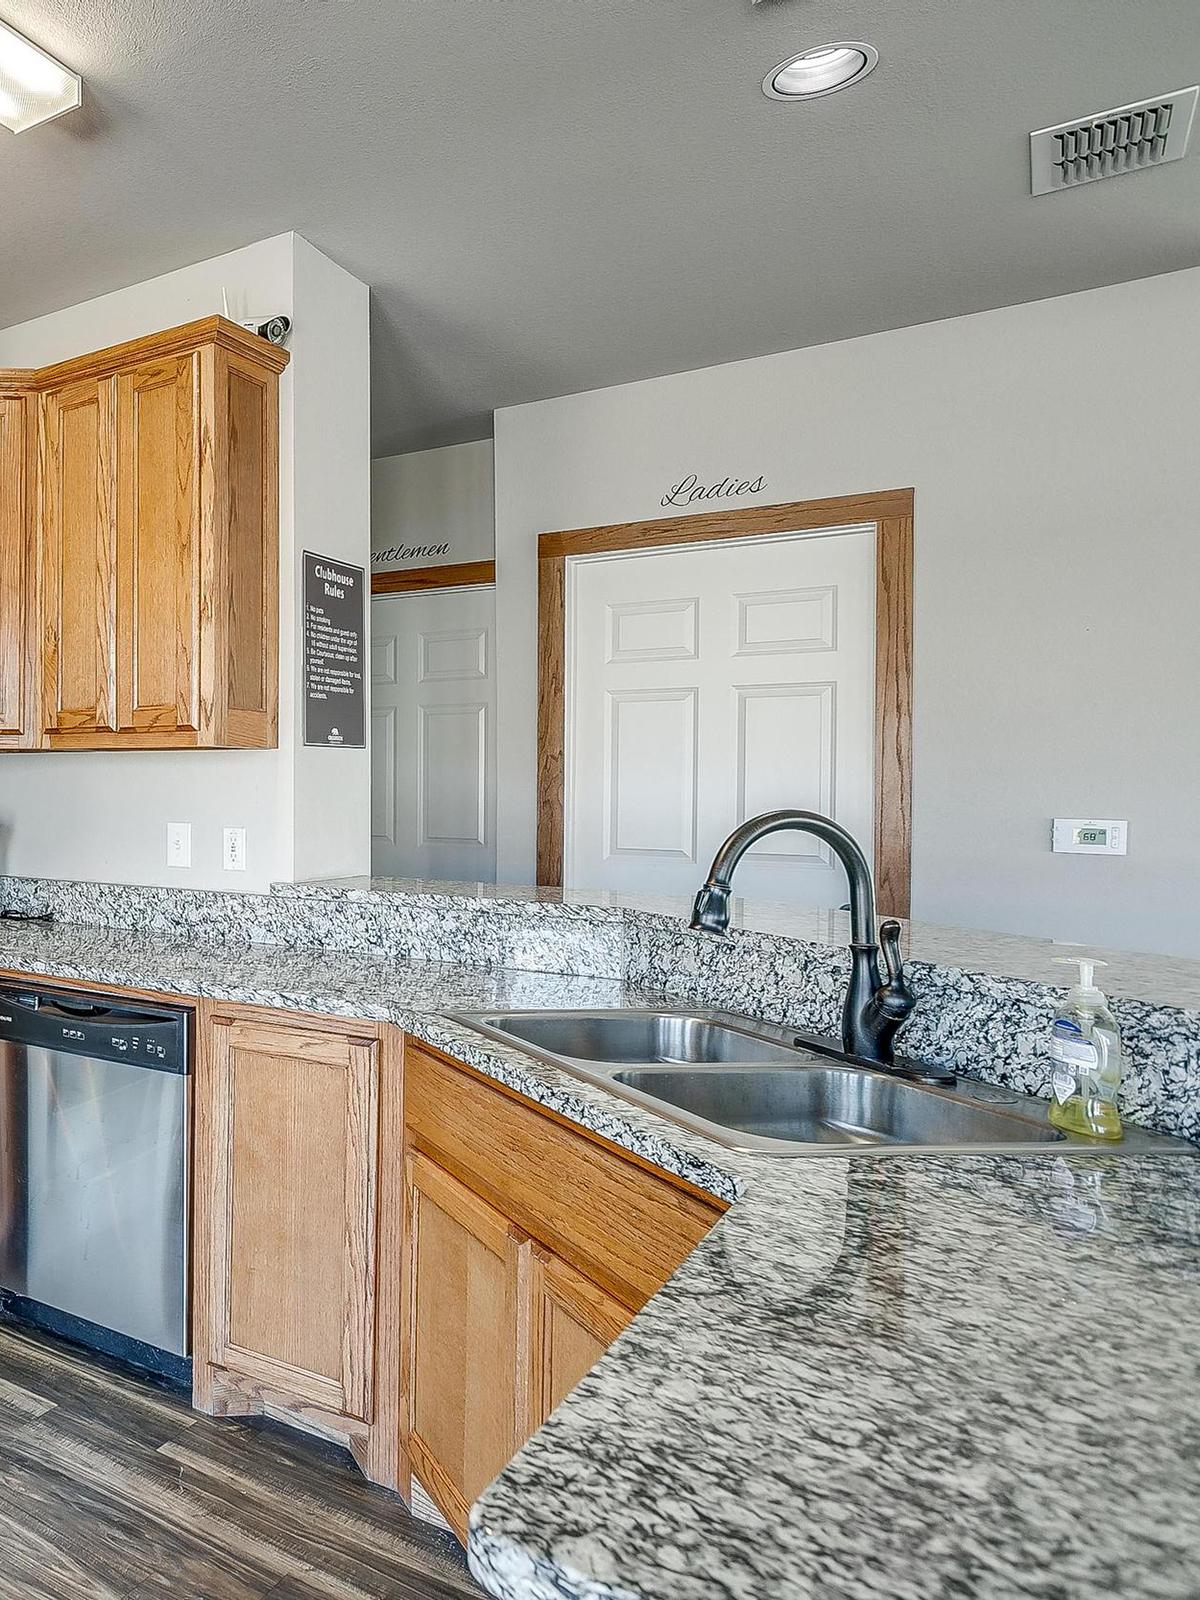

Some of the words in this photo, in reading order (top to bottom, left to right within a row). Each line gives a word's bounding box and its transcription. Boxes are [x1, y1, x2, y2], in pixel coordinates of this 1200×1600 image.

[661, 474, 768, 507] Ladies
[371, 542, 451, 564] entlemen
[314, 565, 354, 587] Clubhouse
[324, 582, 345, 600] Rules
